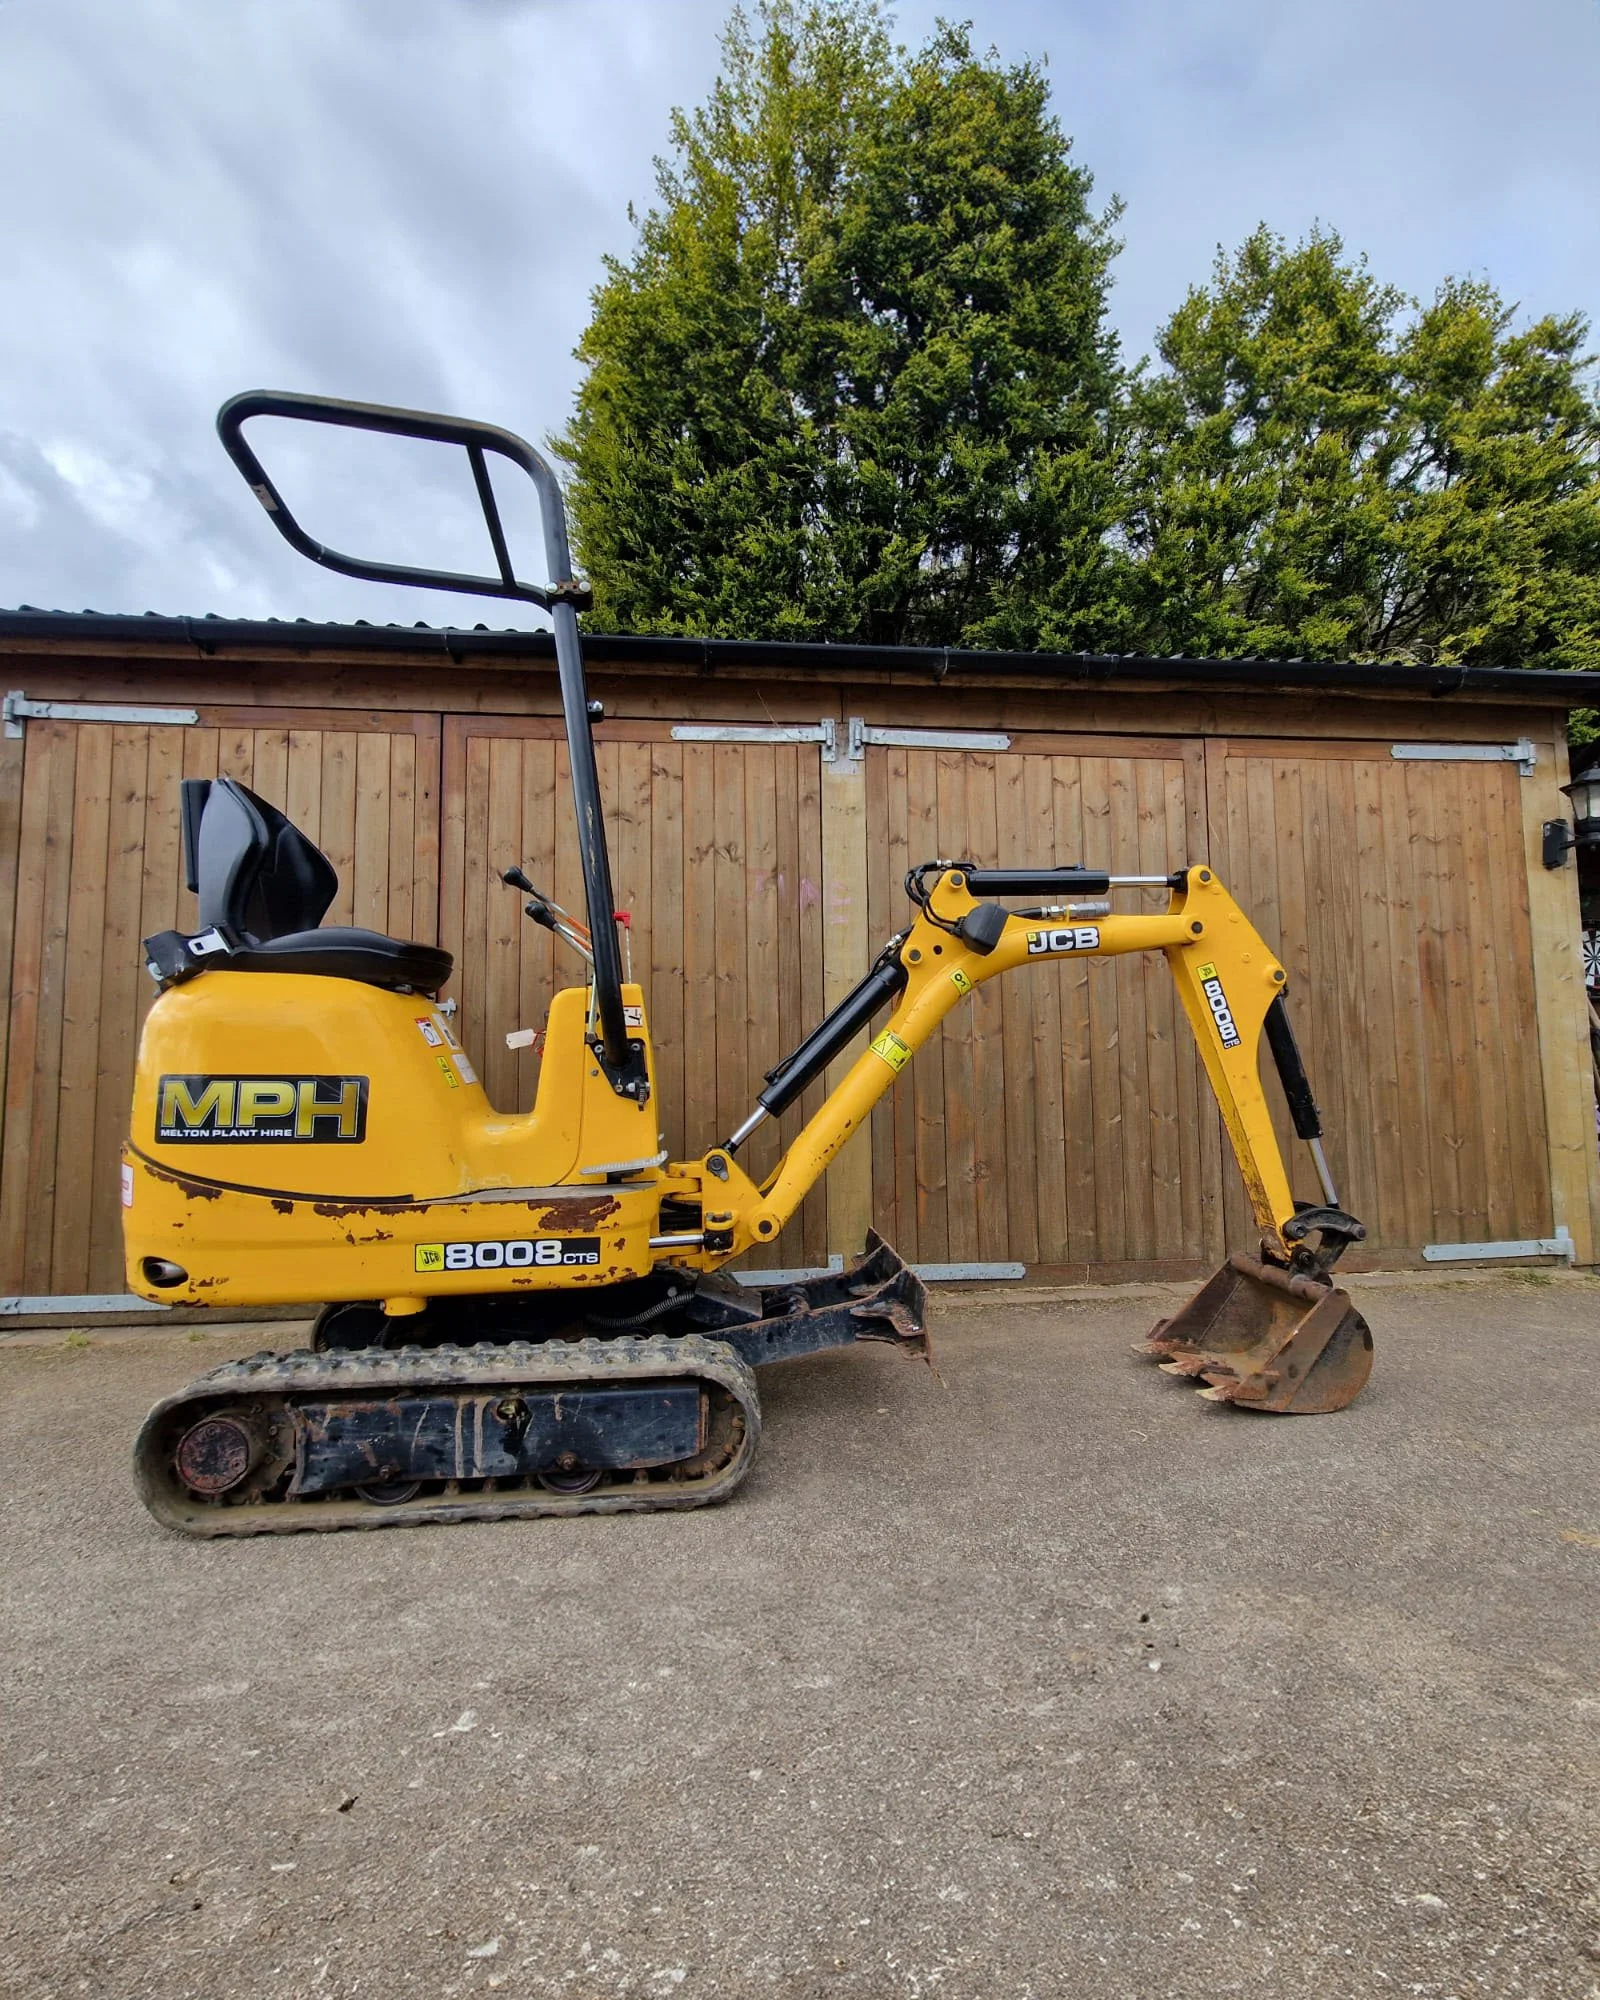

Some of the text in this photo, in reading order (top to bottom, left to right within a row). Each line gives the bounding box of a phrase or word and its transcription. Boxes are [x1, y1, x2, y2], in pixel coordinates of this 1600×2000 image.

[1029, 927, 1099, 953] JCB
[1204, 980, 1237, 1040] 8008
[160, 1081, 361, 1138] MPH
[160, 1129, 293, 1137] MELTON PLANT HIRE
[423, 1240, 598, 1269] JCB 8008 CTS
